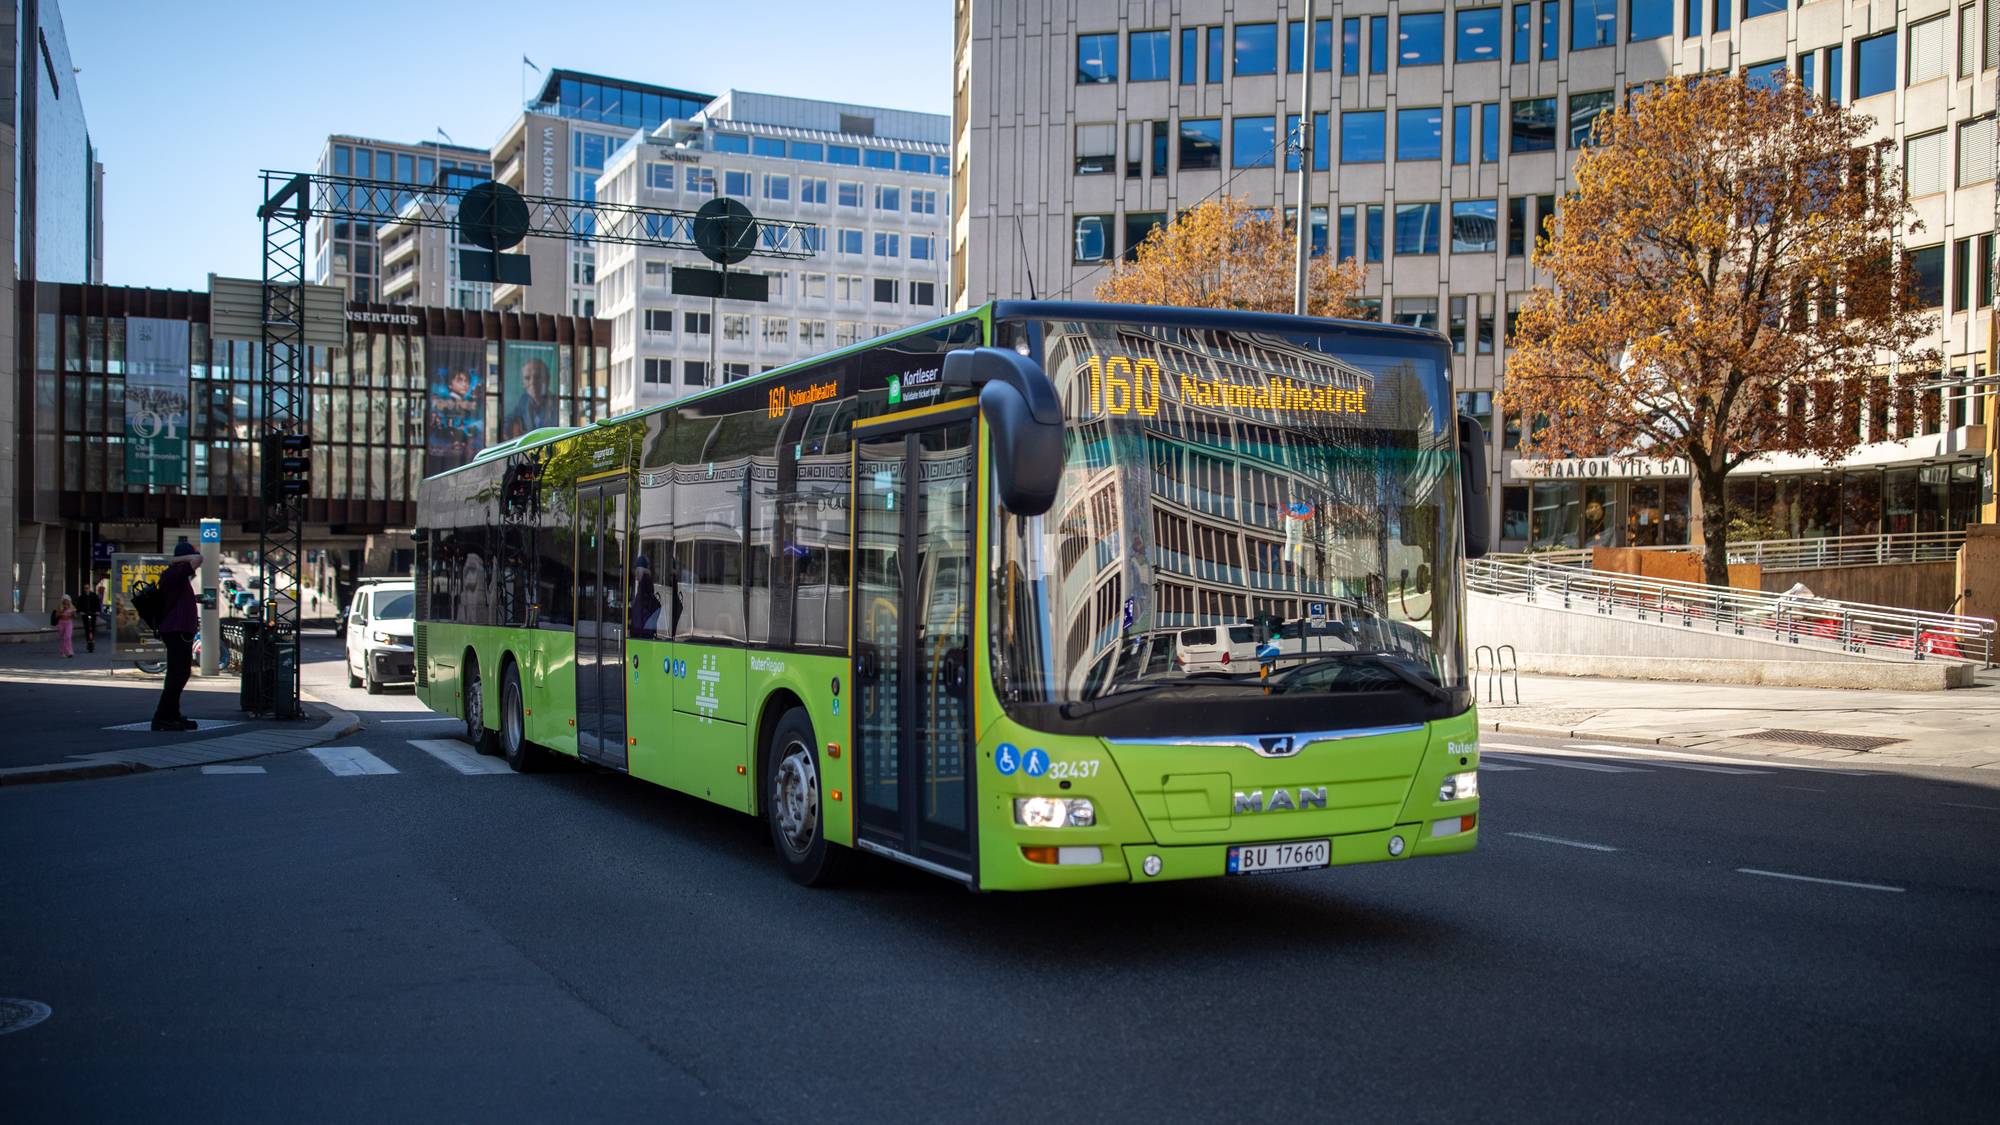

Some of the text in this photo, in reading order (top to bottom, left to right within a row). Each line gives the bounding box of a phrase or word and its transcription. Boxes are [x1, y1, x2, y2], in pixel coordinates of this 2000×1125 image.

[543, 127, 554, 200] WIKBORG
[660, 150, 702, 163] Selmer
[345, 311, 418, 325] NSERTHUS
[903, 367, 938, 387] Kortleser
[1088, 355, 1367, 416] 160 Nationaltheatret
[768, 381, 837, 419] 160 Nationaltheatret
[121, 565, 169, 574] CLARKSO
[1448, 741, 1478, 755] Ruter
[1049, 760, 1099, 779] 32437
[1234, 787, 1327, 813] MAN
[1244, 844, 1324, 868] BU 17660
